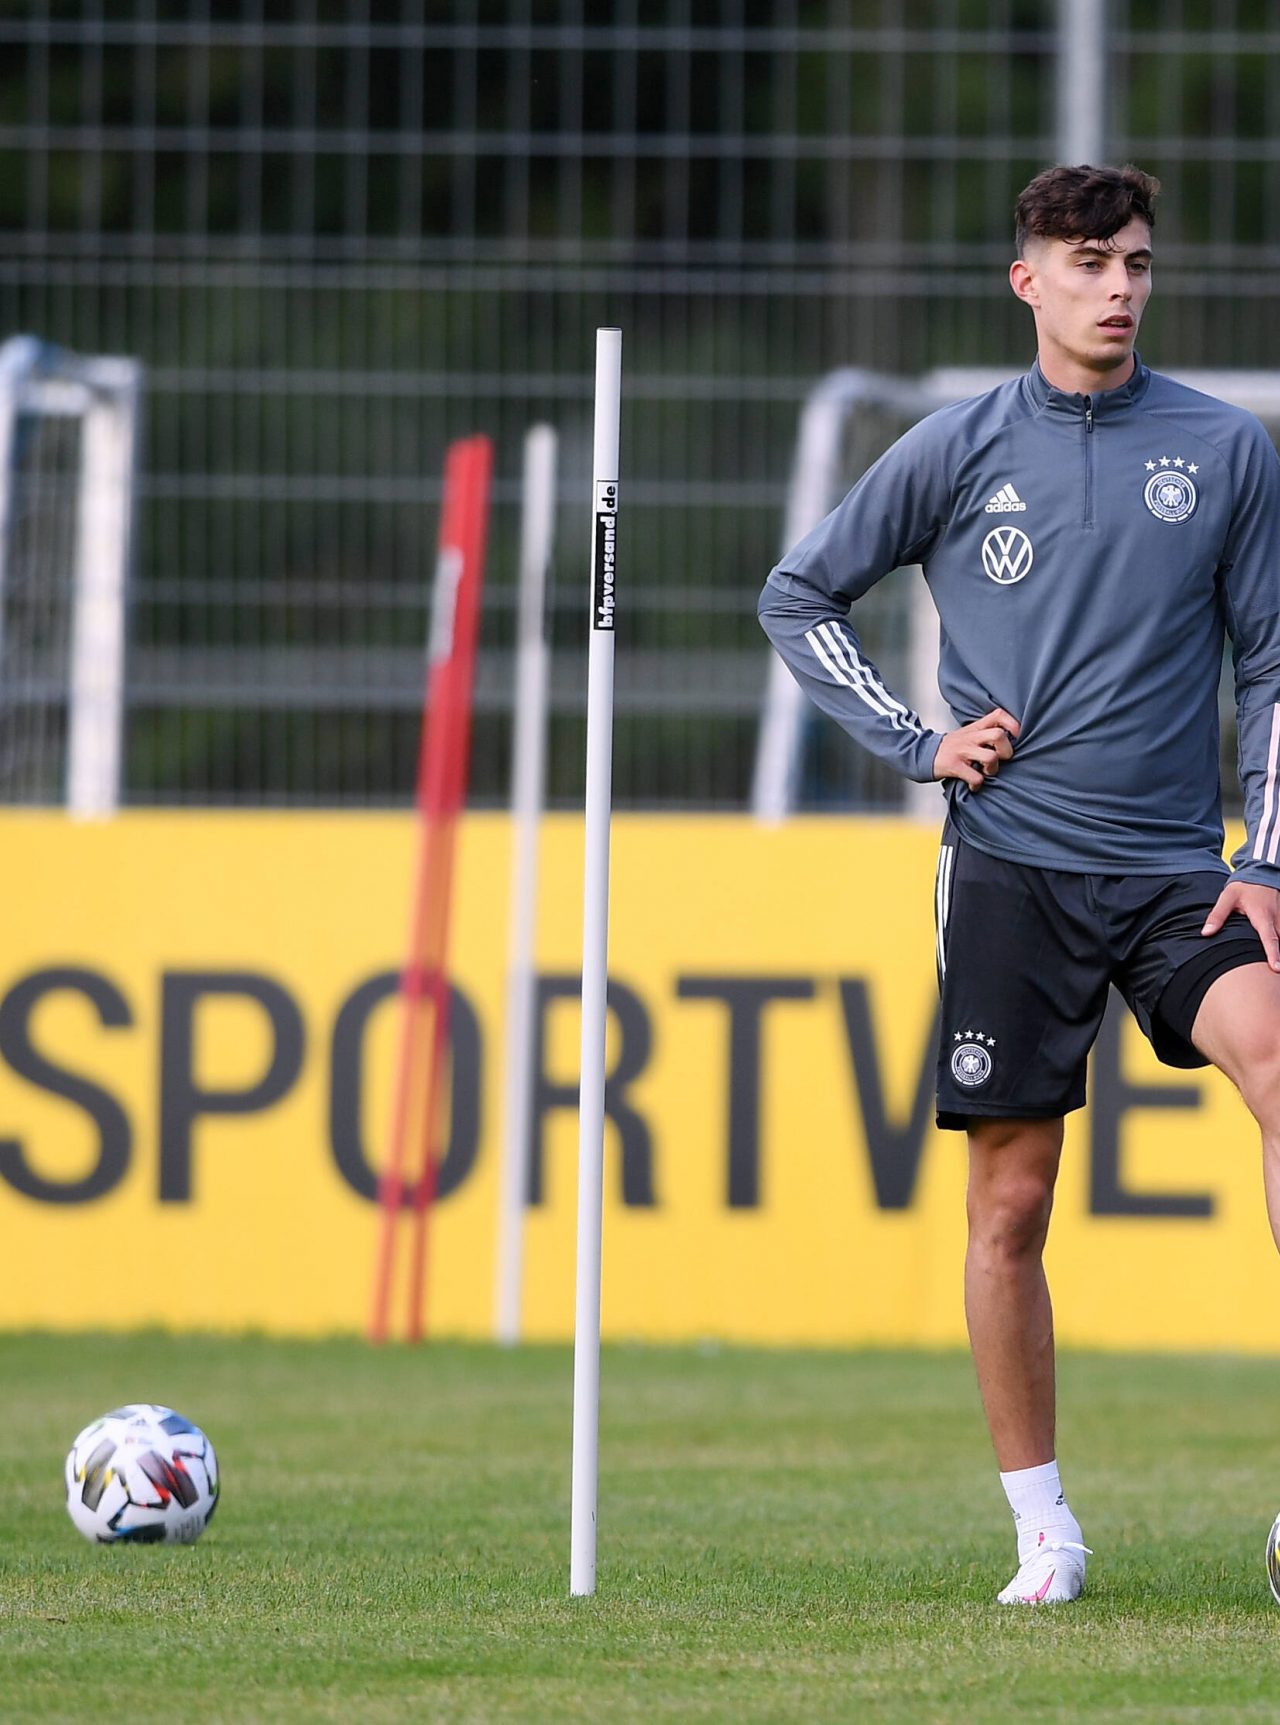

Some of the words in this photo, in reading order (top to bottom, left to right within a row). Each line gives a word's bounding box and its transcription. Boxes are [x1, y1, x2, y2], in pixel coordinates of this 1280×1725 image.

[984, 501, 1028, 513] adidas
[598, 485, 617, 628] bfpversand.de
[982, 526, 1034, 585] VW
